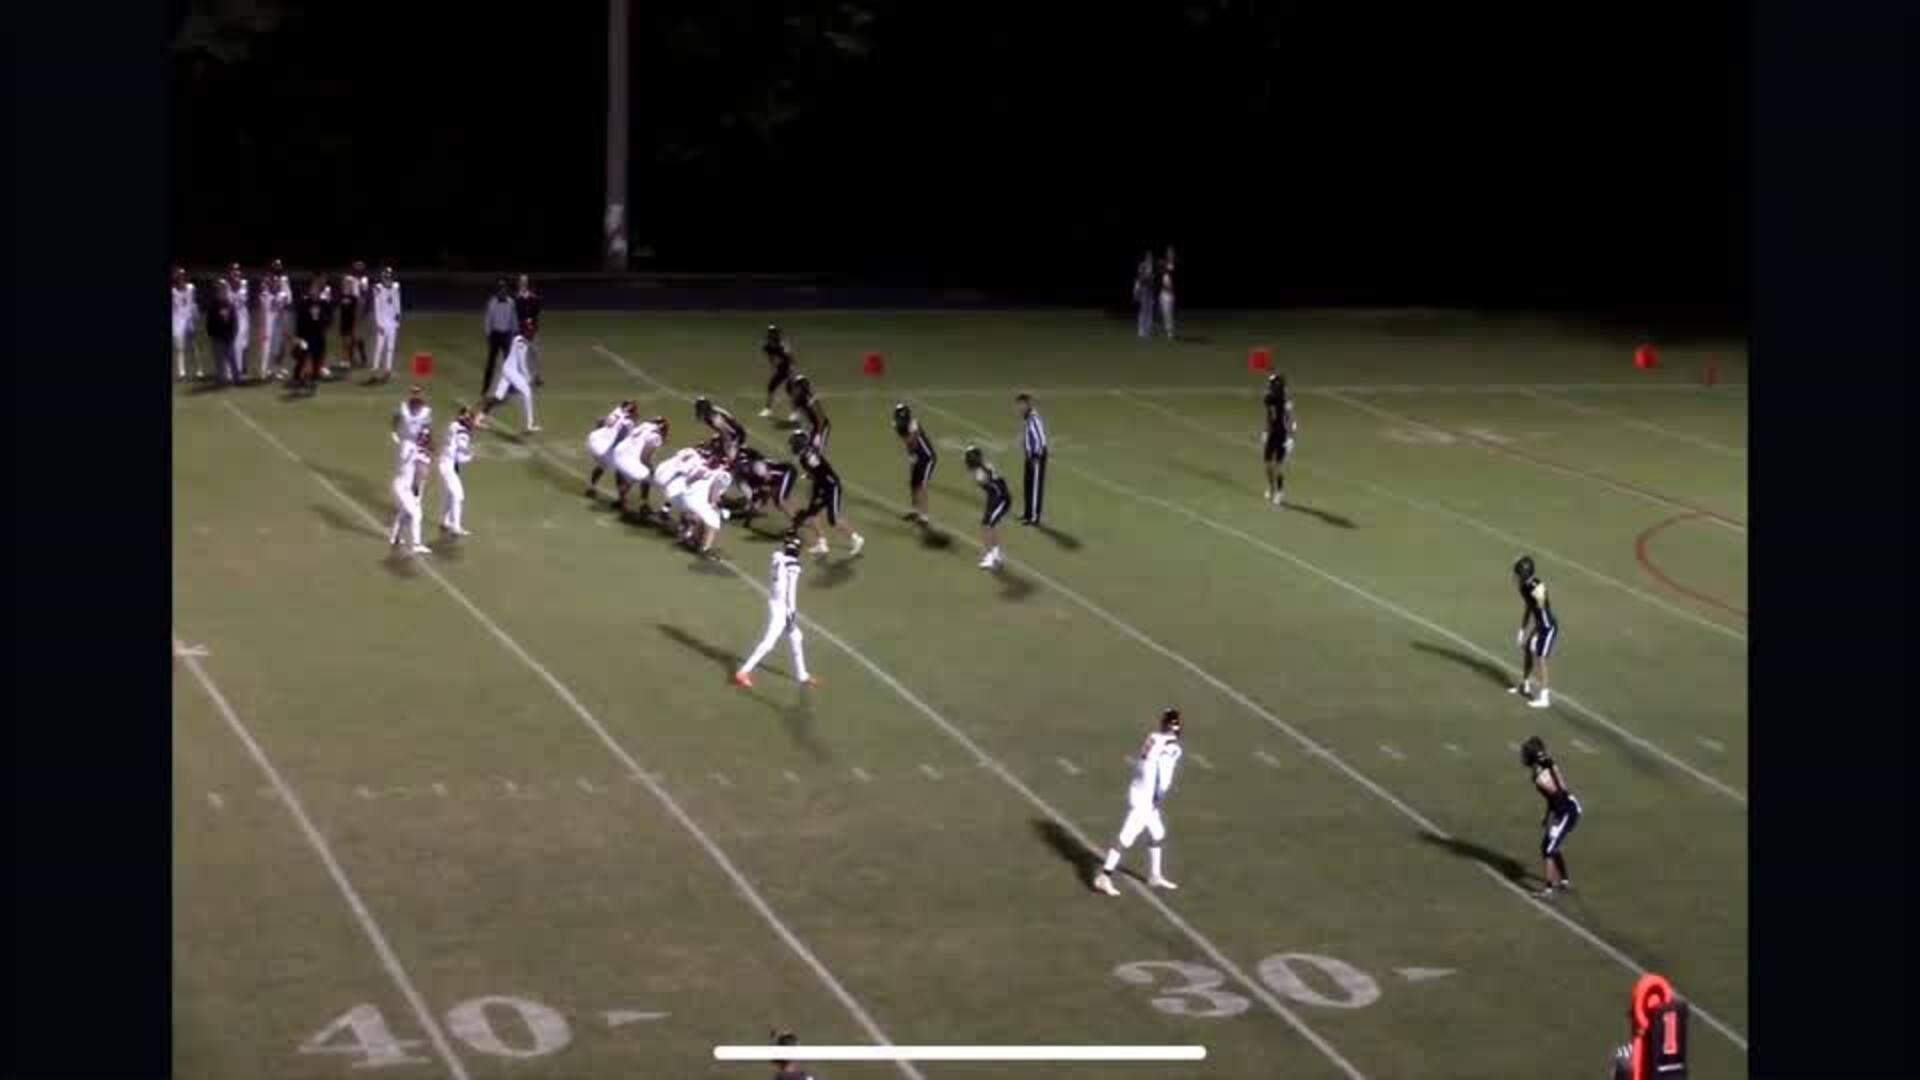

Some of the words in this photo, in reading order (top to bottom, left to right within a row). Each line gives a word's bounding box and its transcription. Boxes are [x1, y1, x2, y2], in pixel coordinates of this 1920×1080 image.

[1114, 953, 1381, 1017] 30
[299, 996, 572, 1068] 40
[1662, 1011, 1678, 1054] 1
